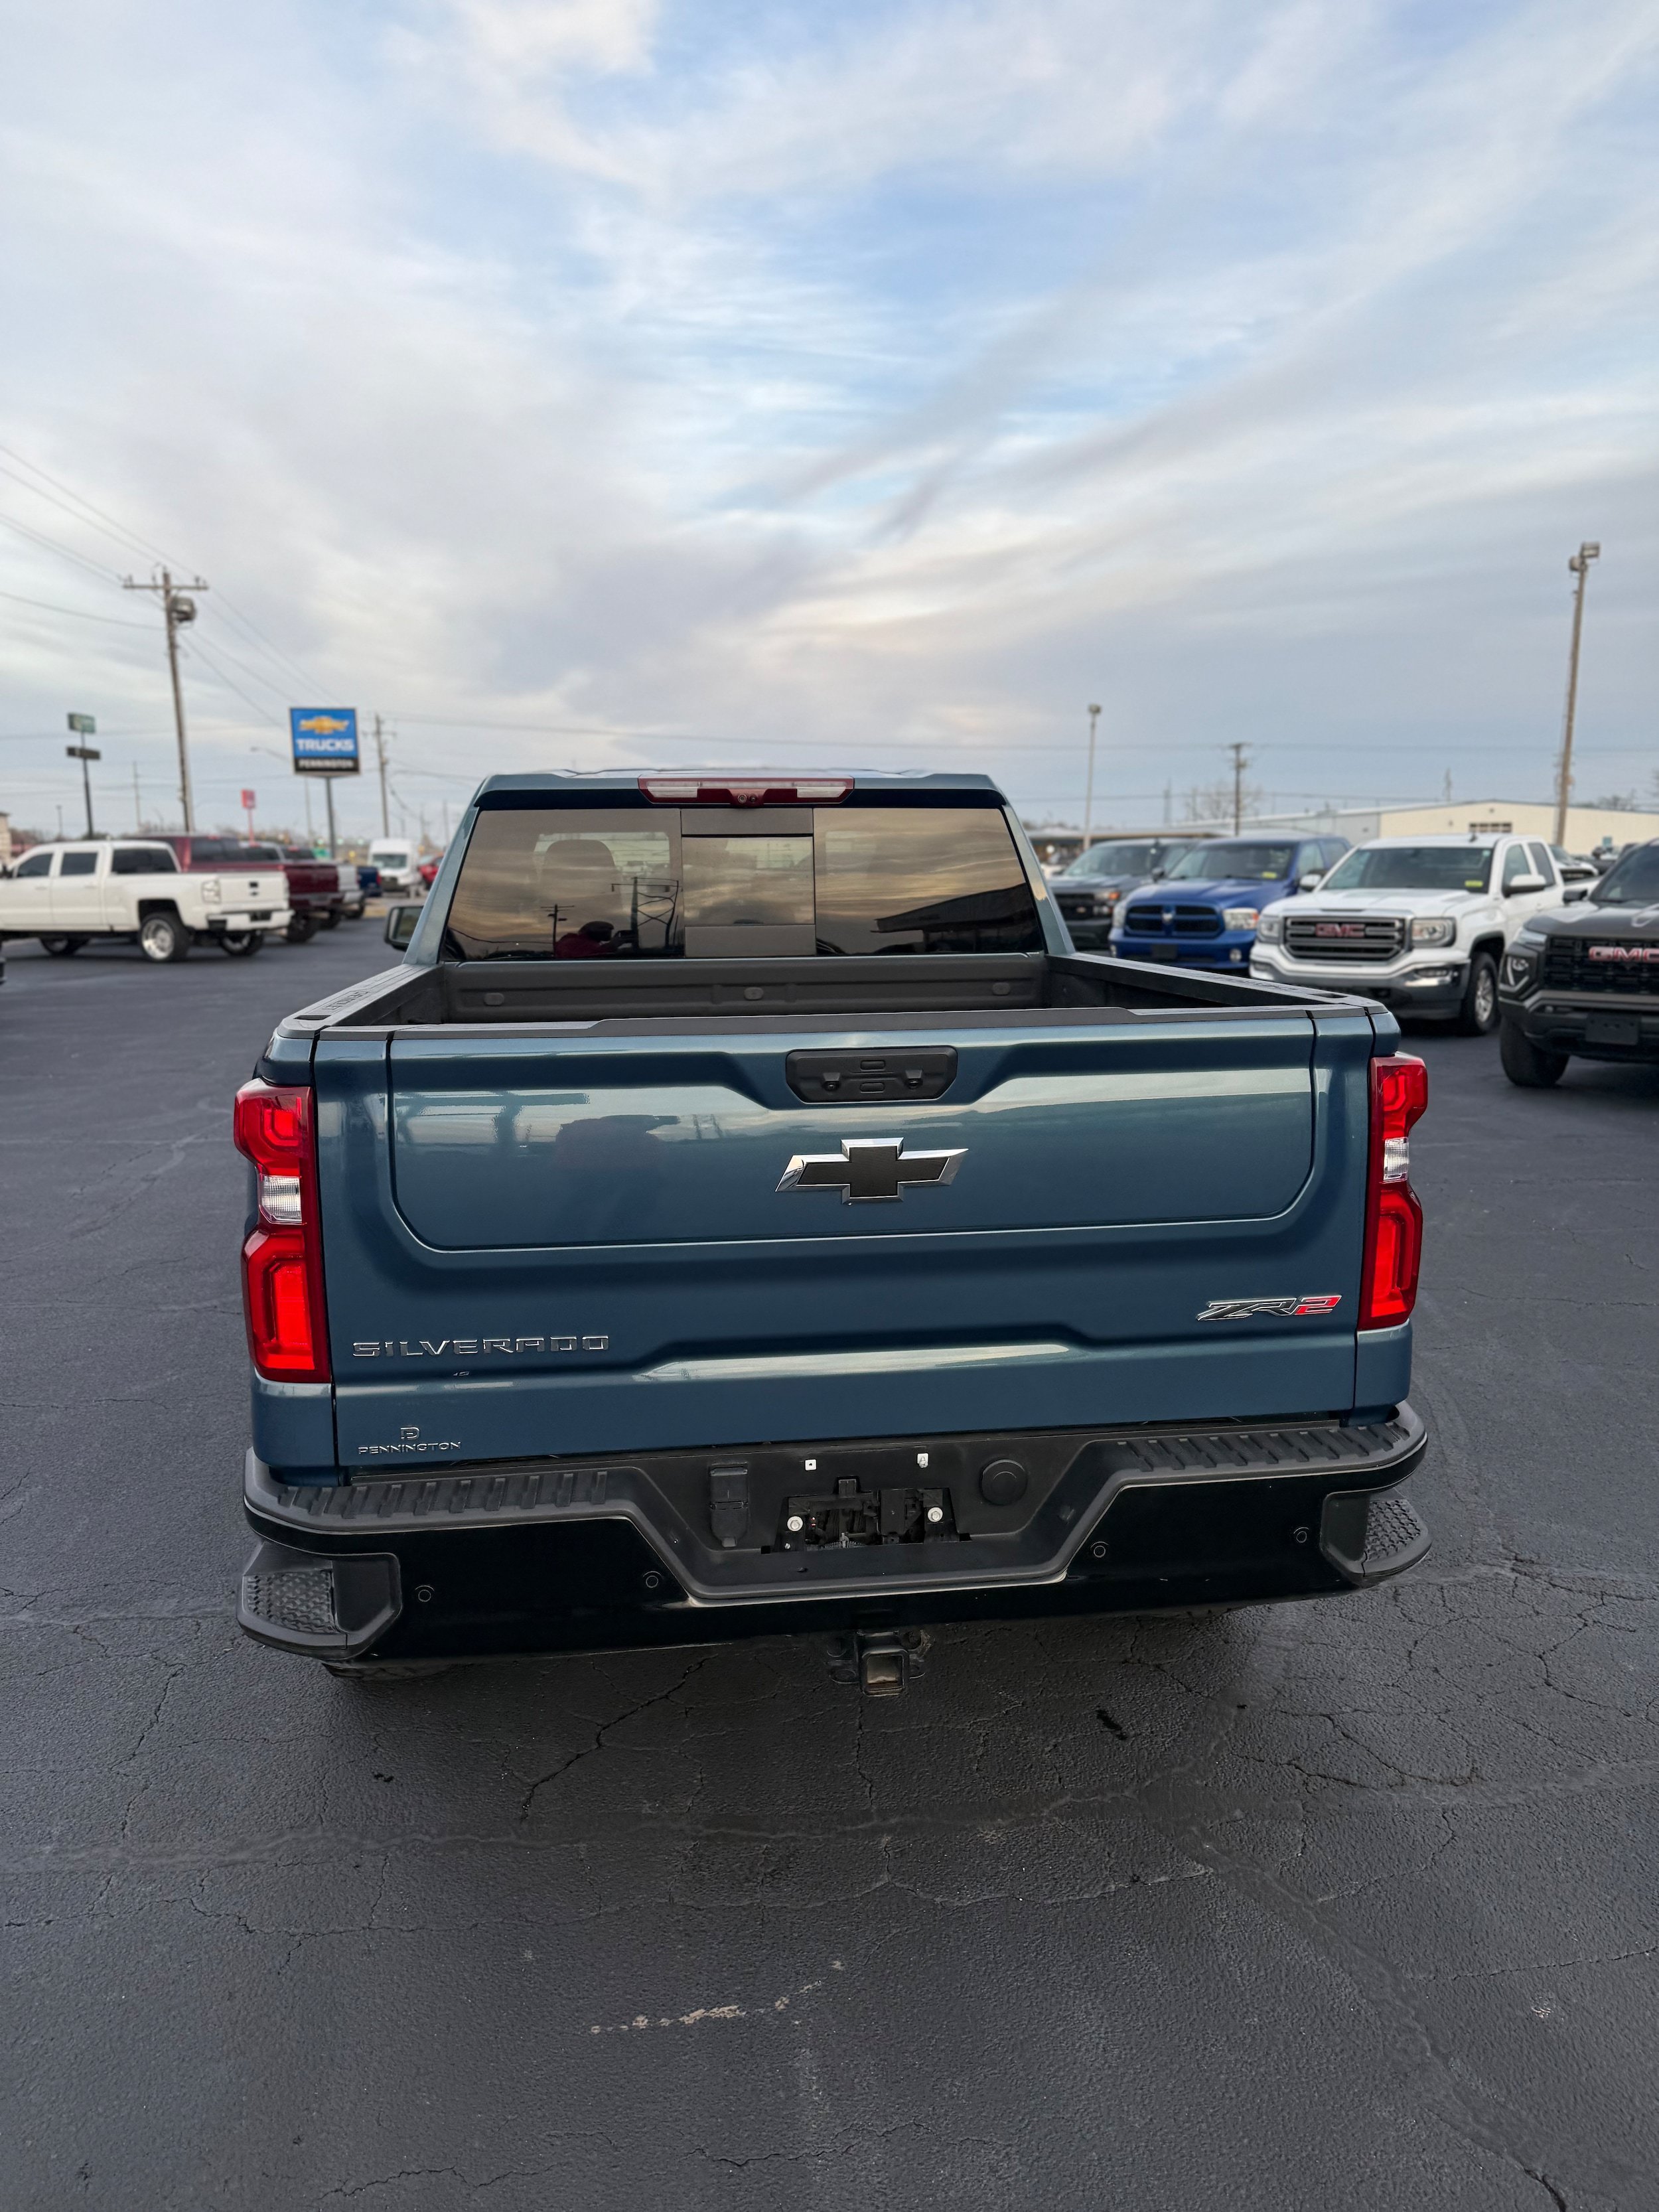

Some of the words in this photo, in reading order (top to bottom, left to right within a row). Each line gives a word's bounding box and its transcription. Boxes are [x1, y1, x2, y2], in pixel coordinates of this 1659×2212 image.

[296, 738, 354, 752] TRUCKS
[1315, 923, 1365, 937] GMC
[1589, 946, 1659, 963] GMC
[1196, 1295, 1342, 1321] ZR2
[353, 1336, 609, 1357] SILVERADO
[358, 1441, 461, 1455] PENNINGTON
